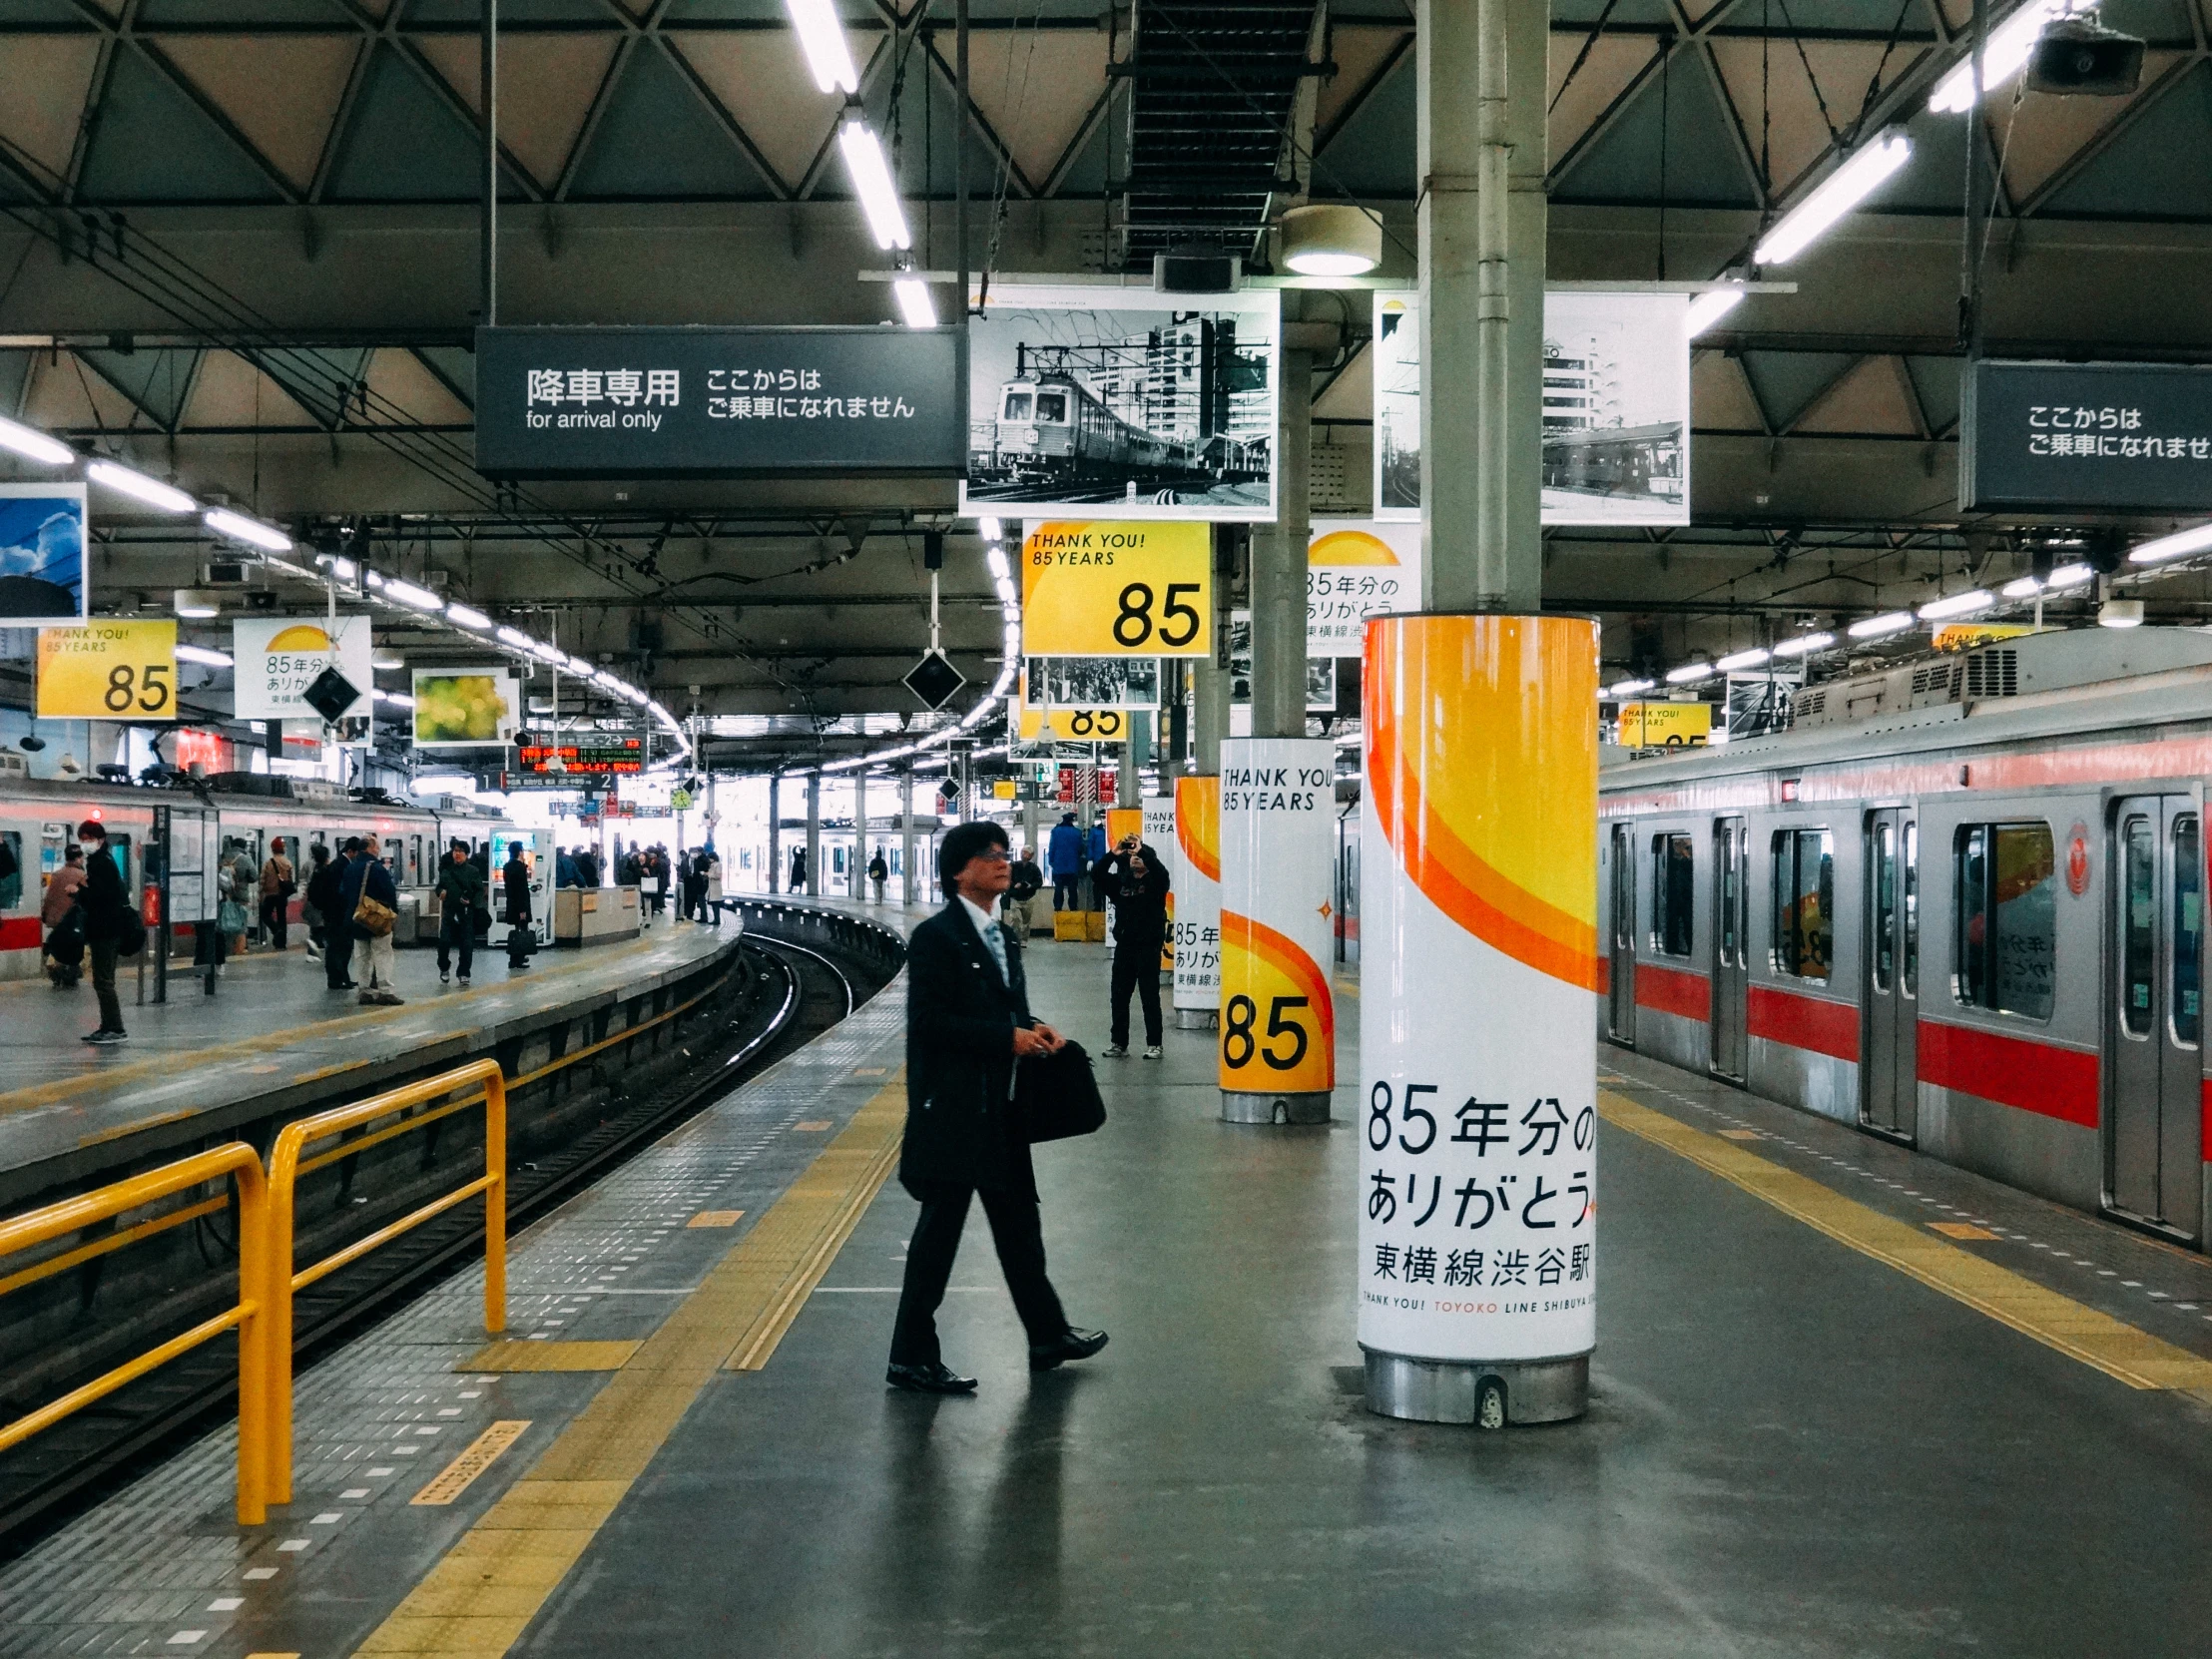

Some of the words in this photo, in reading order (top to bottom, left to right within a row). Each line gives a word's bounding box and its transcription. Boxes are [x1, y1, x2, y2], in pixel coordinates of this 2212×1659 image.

[527, 368, 681, 406] 降車専用
[707, 369, 822, 391] ここからは
[707, 396, 915, 419] ご乗車になれません
[2028, 406, 2142, 429] ここからは
[526, 410, 552, 428] for
[557, 410, 617, 428] arrival
[621, 410, 663, 432] only
[2028, 433, 2212, 459] ご乗車になれませ
[1032, 534, 1093, 548] THANK
[1100, 534, 1145, 548] YOU!
[1032, 551, 1053, 565] 85
[1057, 551, 1115, 565] YEARS
[1113, 582, 1201, 647] 85
[47, 629, 90, 639] THANK
[97, 629, 129, 640] YOU!
[47, 642, 61, 652] 85
[65, 642, 107, 652] YEARS
[267, 656, 331, 674] 85年分
[105, 665, 169, 712] 85
[267, 678, 310, 691] ありが
[1071, 710, 1121, 736] 85
[604, 736, 612, 746] 2
[601, 774, 611, 789] 2
[1224, 769, 1288, 787] THANK
[1224, 793, 1239, 811] 85
[1243, 792, 1315, 811] YEARS
[1176, 922, 1220, 946] 85年
[1224, 994, 1309, 1071] 85
[1369, 1080, 1595, 1158] 85年分の
[1369, 1169, 1590, 1230] ありがとう
[1374, 1243, 1590, 1287] 東横線渋谷駅
[1364, 1291, 1388, 1306] THANK
[1393, 1298, 1425, 1311] YOU!
[1434, 1301, 1497, 1314] TOYOKO
[1505, 1302, 1537, 1314] LINE
[1544, 1297, 1585, 1313] SHIBUYA
